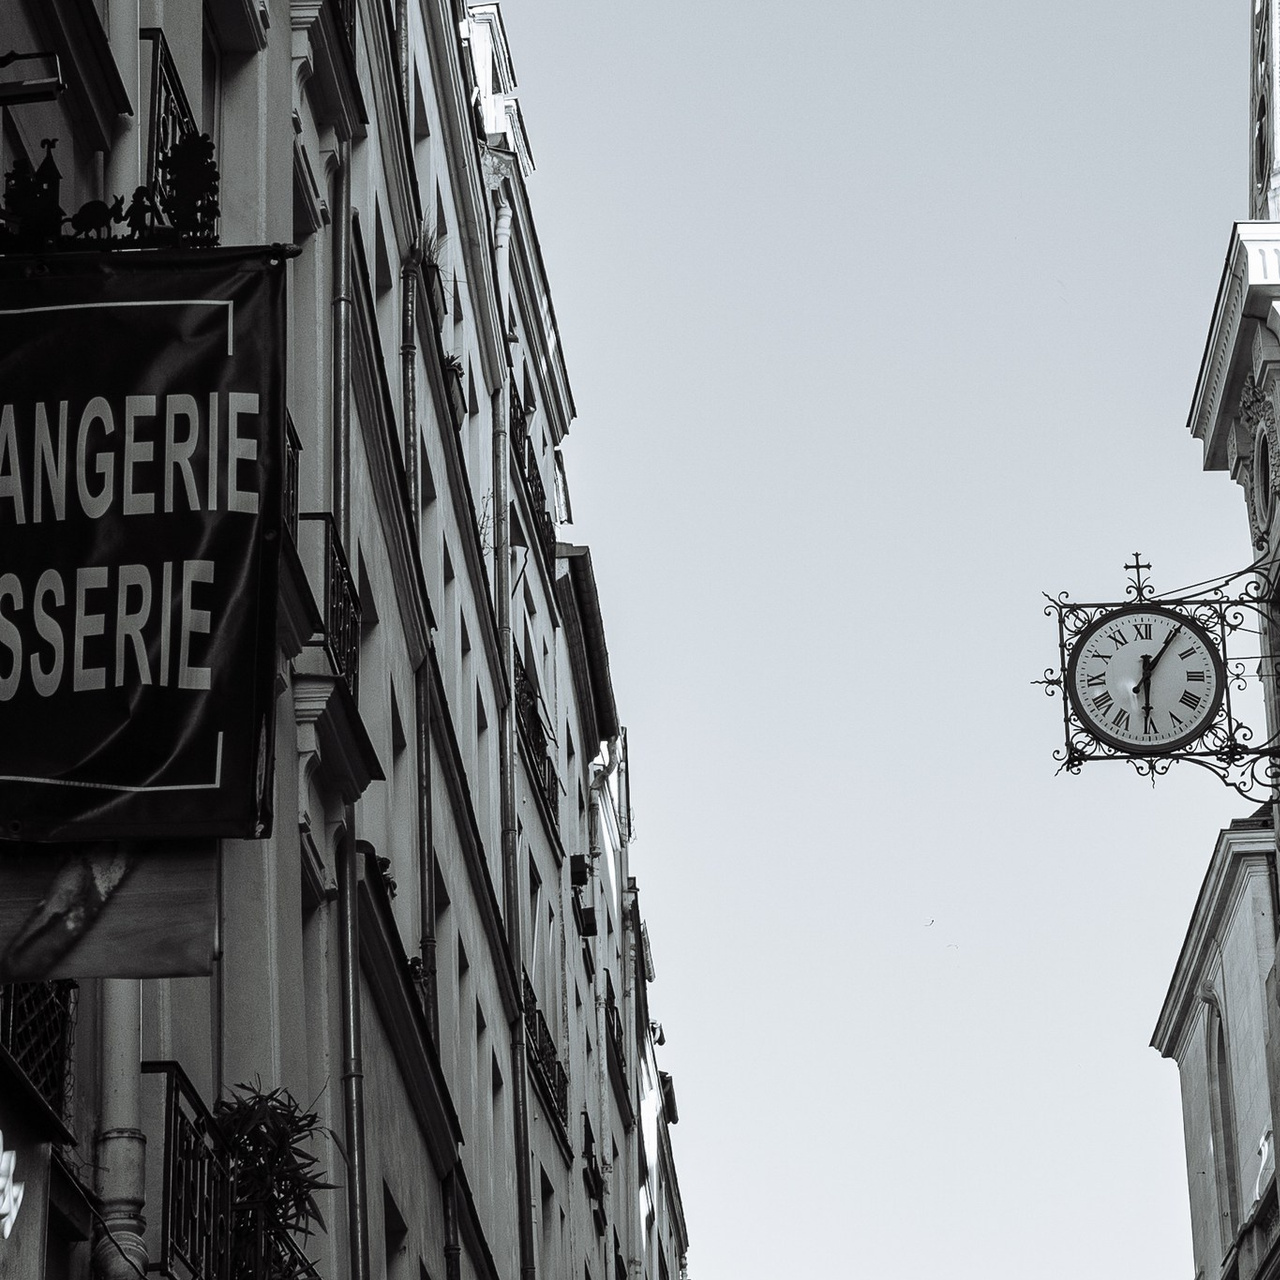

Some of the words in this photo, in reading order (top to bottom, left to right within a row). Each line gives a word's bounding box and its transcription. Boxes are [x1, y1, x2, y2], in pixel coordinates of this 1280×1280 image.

[0, 392, 259, 524] ANGERIE
[0, 560, 215, 701] SSERIE
[1133, 624, 1152, 640] XII
[1186, 670, 1204, 682] III
